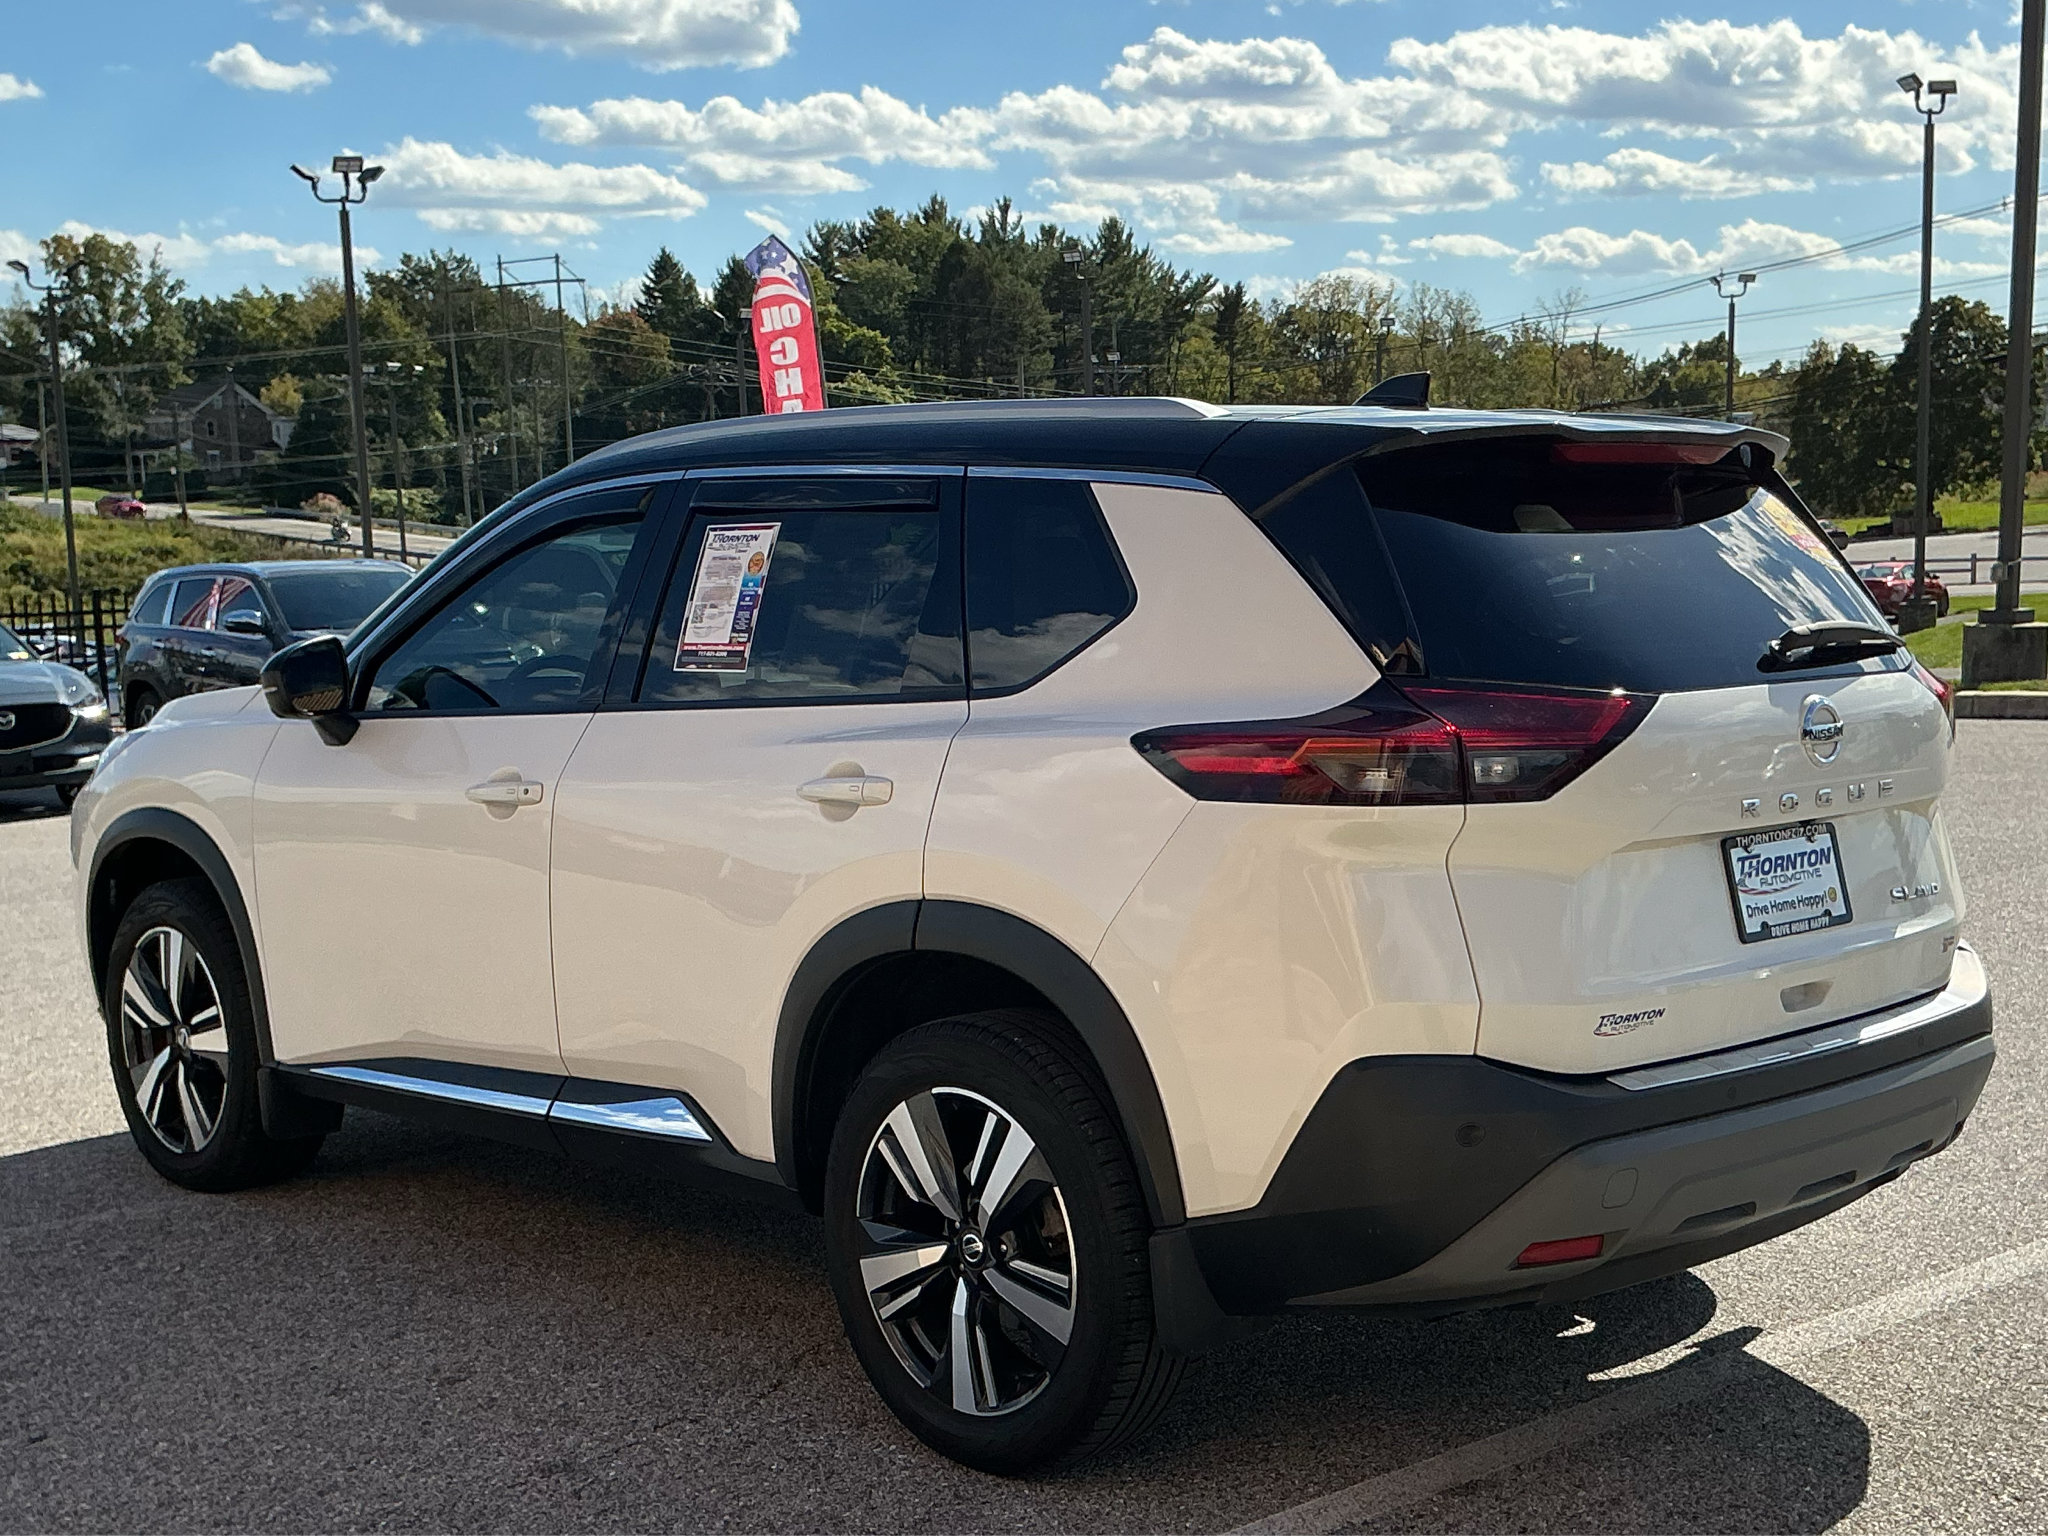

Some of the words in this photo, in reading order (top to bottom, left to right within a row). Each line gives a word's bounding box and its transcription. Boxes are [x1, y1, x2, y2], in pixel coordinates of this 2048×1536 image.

[713, 533, 760, 543] THORNTON
[1809, 724, 1844, 740] NISSAN
[1741, 778, 1893, 819] ROGUE
[1736, 846, 1831, 878] THORNTON
[1760, 867, 1822, 888] AUTOMOTIVE
[1745, 902, 1769, 918] Drive
[1769, 898, 1797, 913] Home
[1796, 889, 1828, 911] Happy!
[1771, 922, 1791, 937] DRIVE
[1790, 919, 1810, 933] HOME
[1810, 916, 1830, 930] HAPPY
[1600, 1008, 1666, 1028] THORNTON
[1610, 1020, 1655, 1032] AUTOMOTIVE
